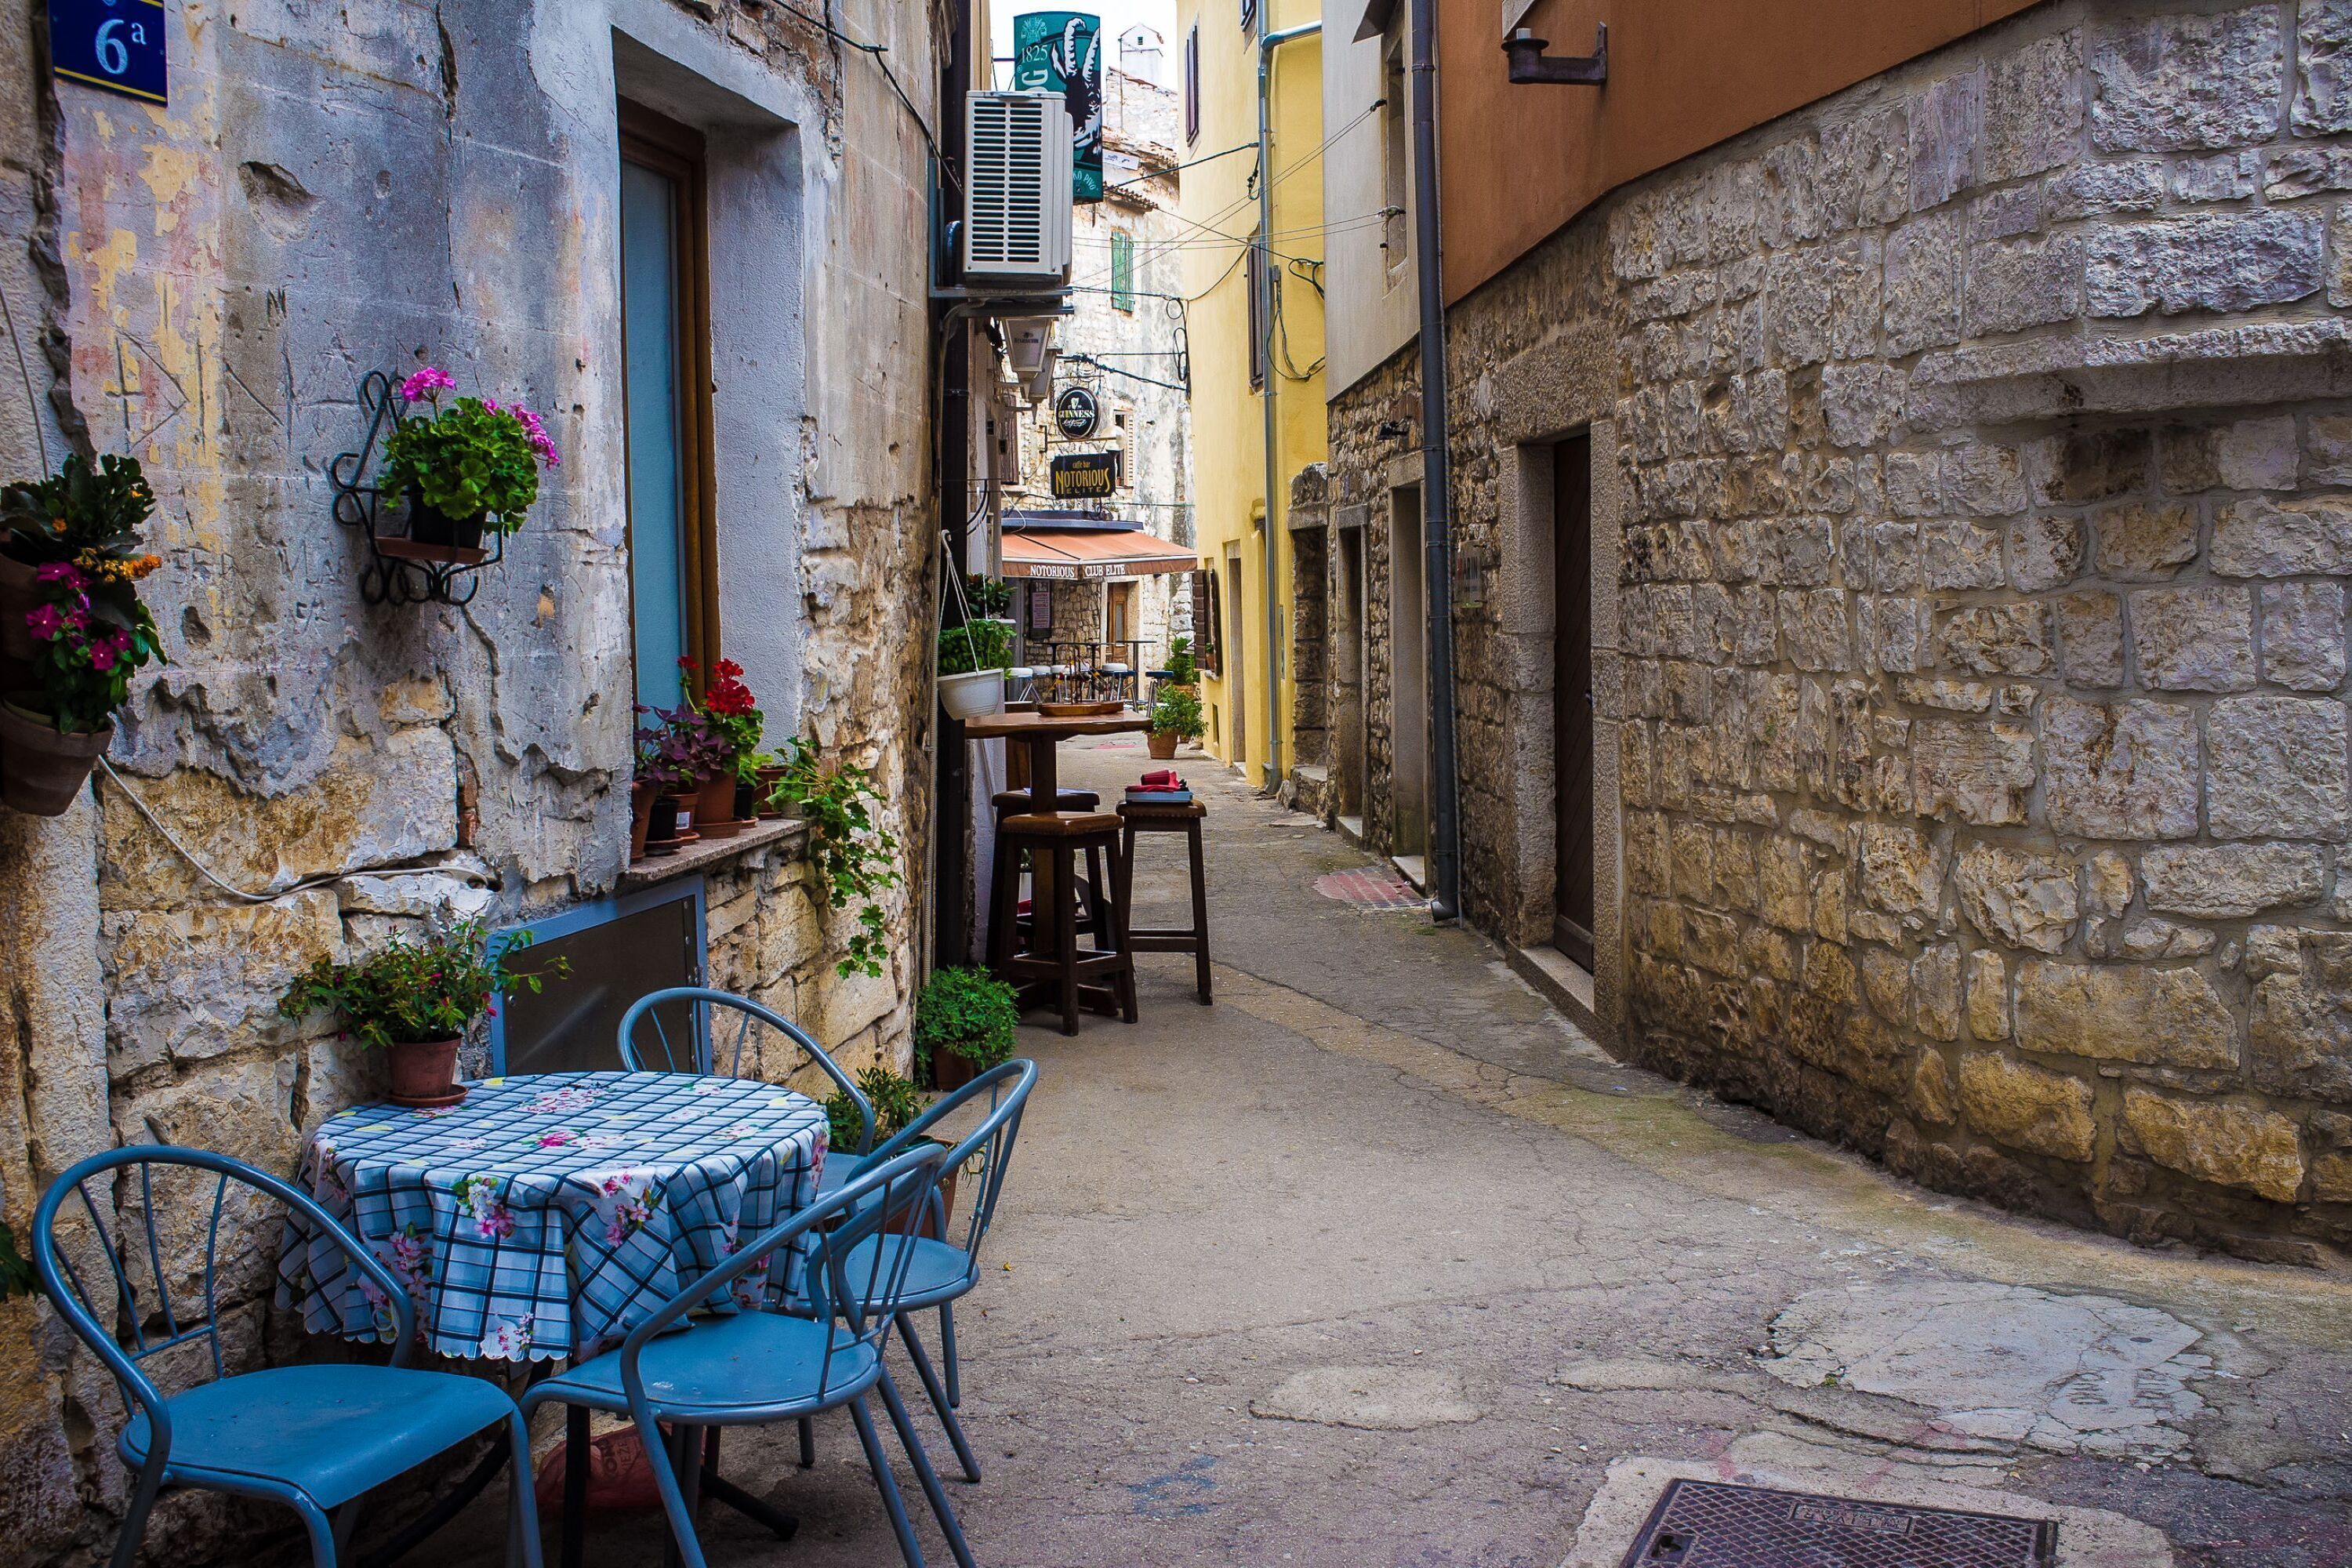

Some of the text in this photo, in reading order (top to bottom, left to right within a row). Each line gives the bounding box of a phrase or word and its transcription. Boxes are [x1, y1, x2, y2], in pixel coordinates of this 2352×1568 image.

[1022, 45, 1047, 64] 1825
[1083, 174, 1097, 191] PIVO
[1058, 409, 1095, 418] GUINNESS
[1055, 467, 1110, 494] NOTORIOUS
[1030, 565, 1075, 578] NOTORIOUS
[1085, 564, 1126, 576] CLUB ELITE
